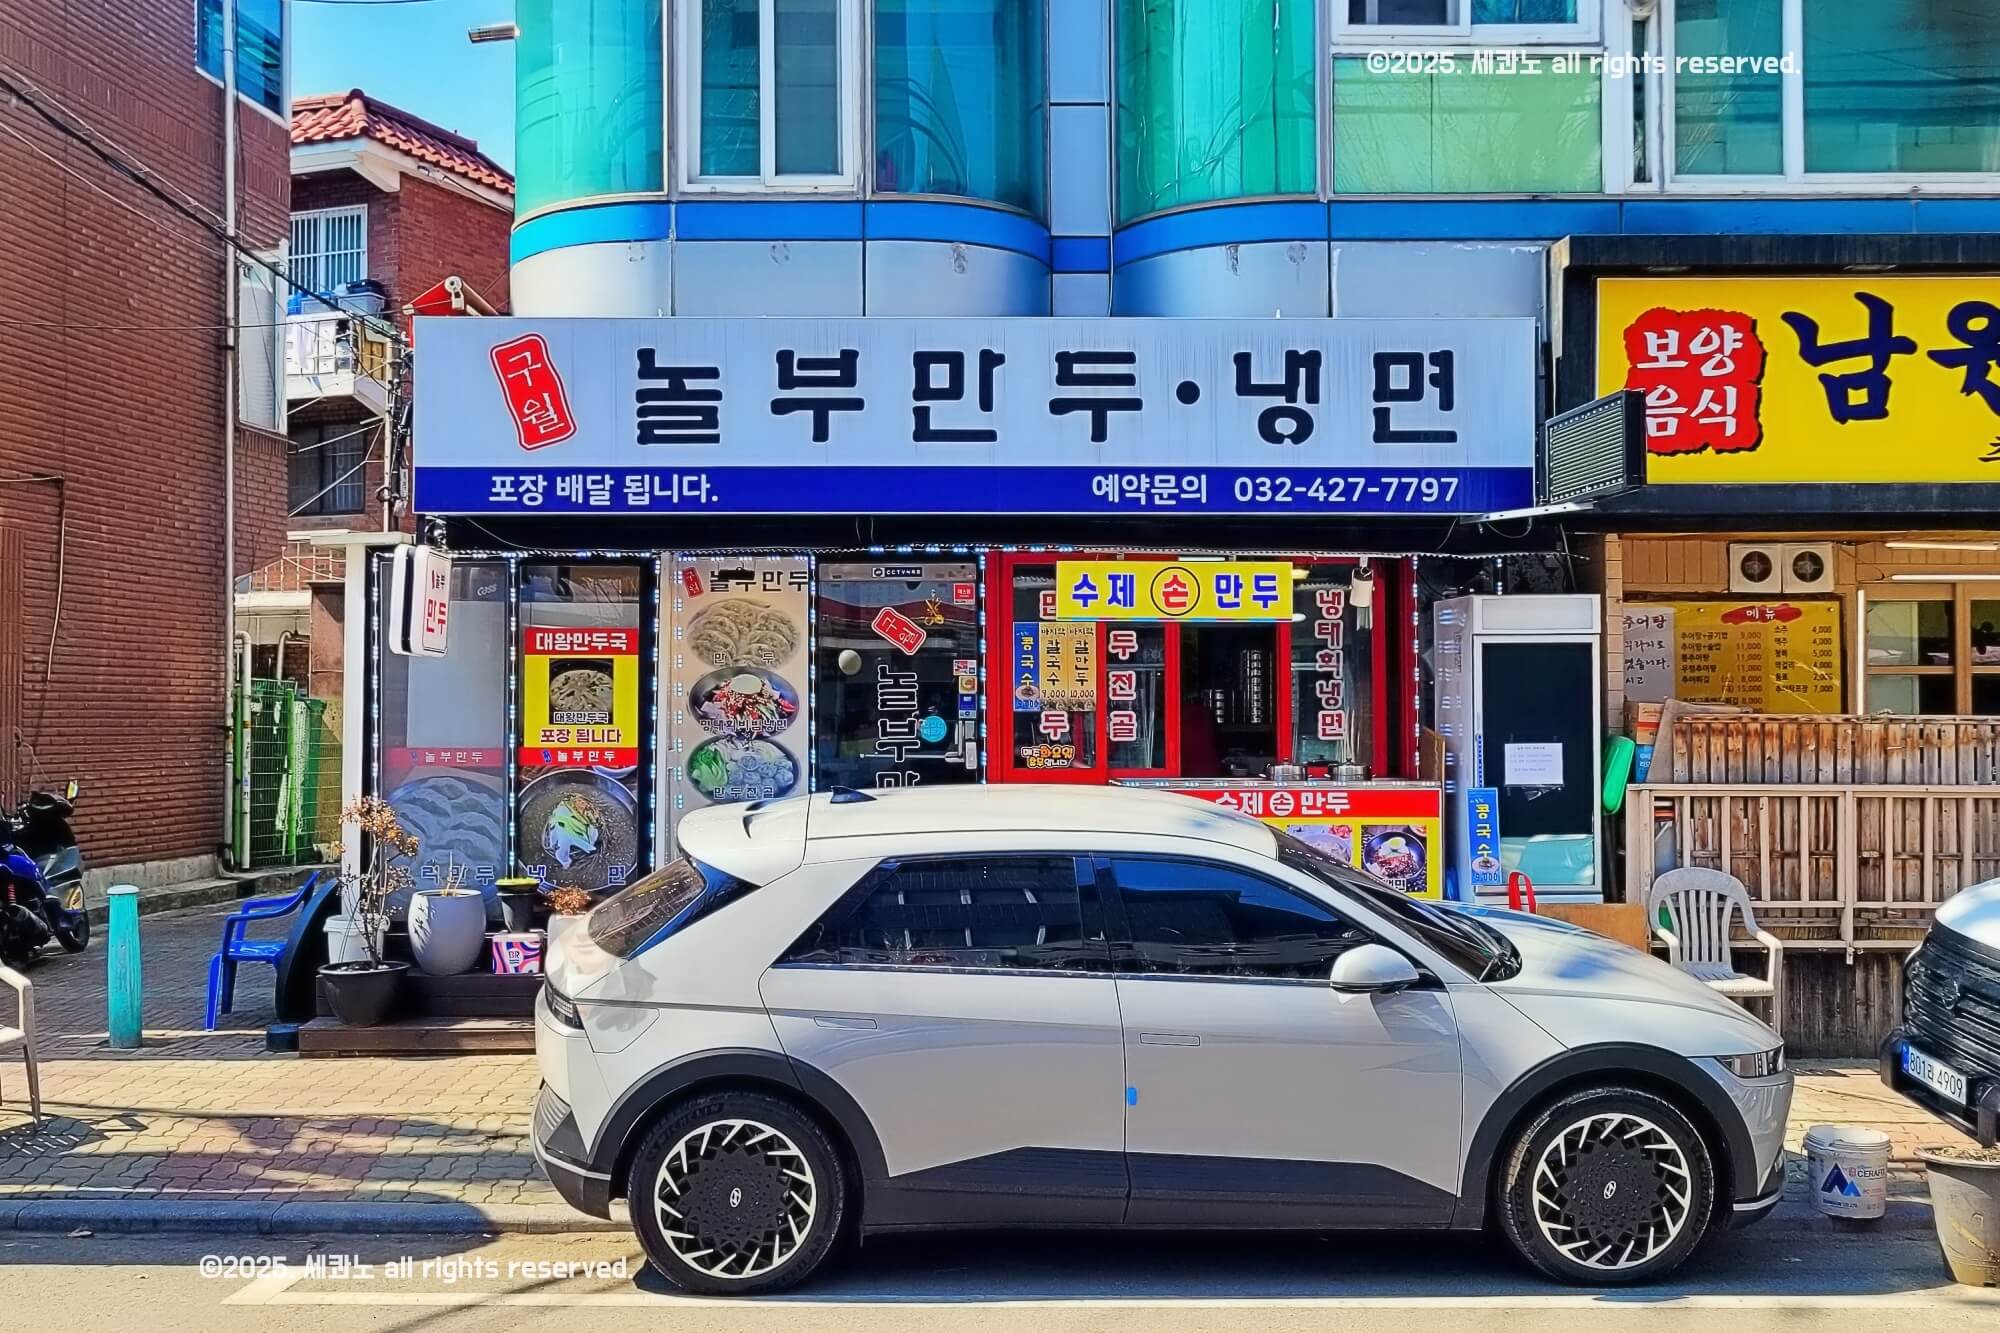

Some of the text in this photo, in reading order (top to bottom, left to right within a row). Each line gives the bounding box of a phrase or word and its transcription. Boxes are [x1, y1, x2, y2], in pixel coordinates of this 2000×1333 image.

[1636, 325, 1744, 377] 보양
[507, 348, 564, 435] 구월
[1645, 385, 1738, 437] 음식
[489, 475, 718, 504] 포장 배달 됩니다.
[1092, 473, 1459, 505] 예약문의 032-427-7797
[1072, 573, 1279, 608] 수제 손 만두
[1746, 608, 1776, 619] 메뉴
[536, 632, 627, 651] 대왕만두국
[714, 653, 775, 665] 만 두
[1046, 639, 1061, 687] 칼국수
[1074, 639, 1090, 687] 칼만두
[554, 712, 609, 724] 대왕만두국
[540, 728, 622, 744] 포장 됩니다
[425, 751, 483, 763] 놀부만두
[1216, 792, 1262, 815] 수제
[1301, 792, 1350, 815] 만두
[1937, 1068, 1963, 1097] 4909
